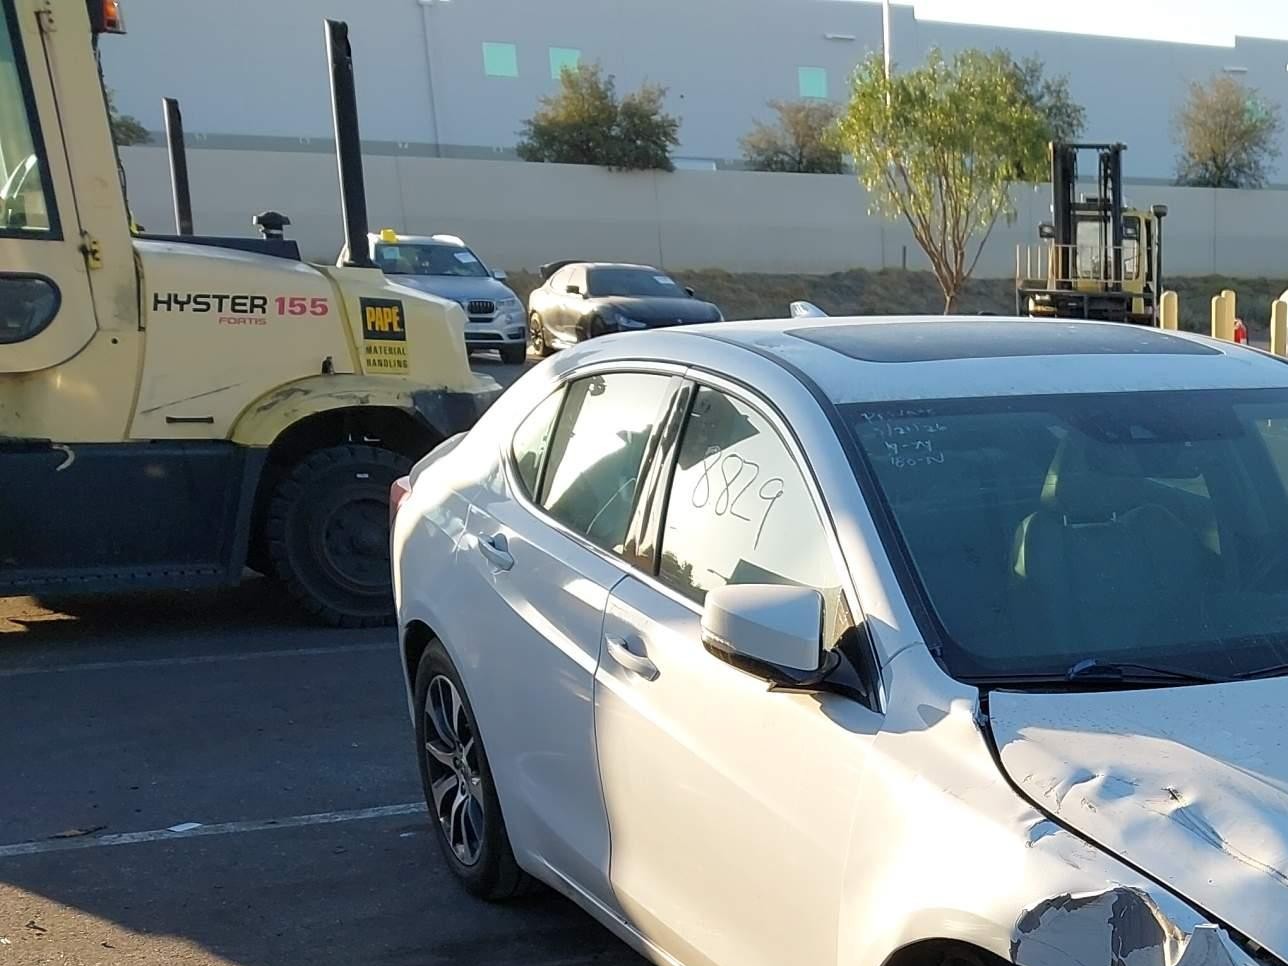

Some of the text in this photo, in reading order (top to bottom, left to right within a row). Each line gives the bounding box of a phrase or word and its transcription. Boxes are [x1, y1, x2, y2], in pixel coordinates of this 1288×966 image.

[153, 293, 329, 316] HYSTER 155
[218, 317, 267, 325] FORTIS
[365, 345, 407, 356] MATERIAL
[366, 358, 409, 369] HANDLING
[692, 445, 784, 551] 8829
